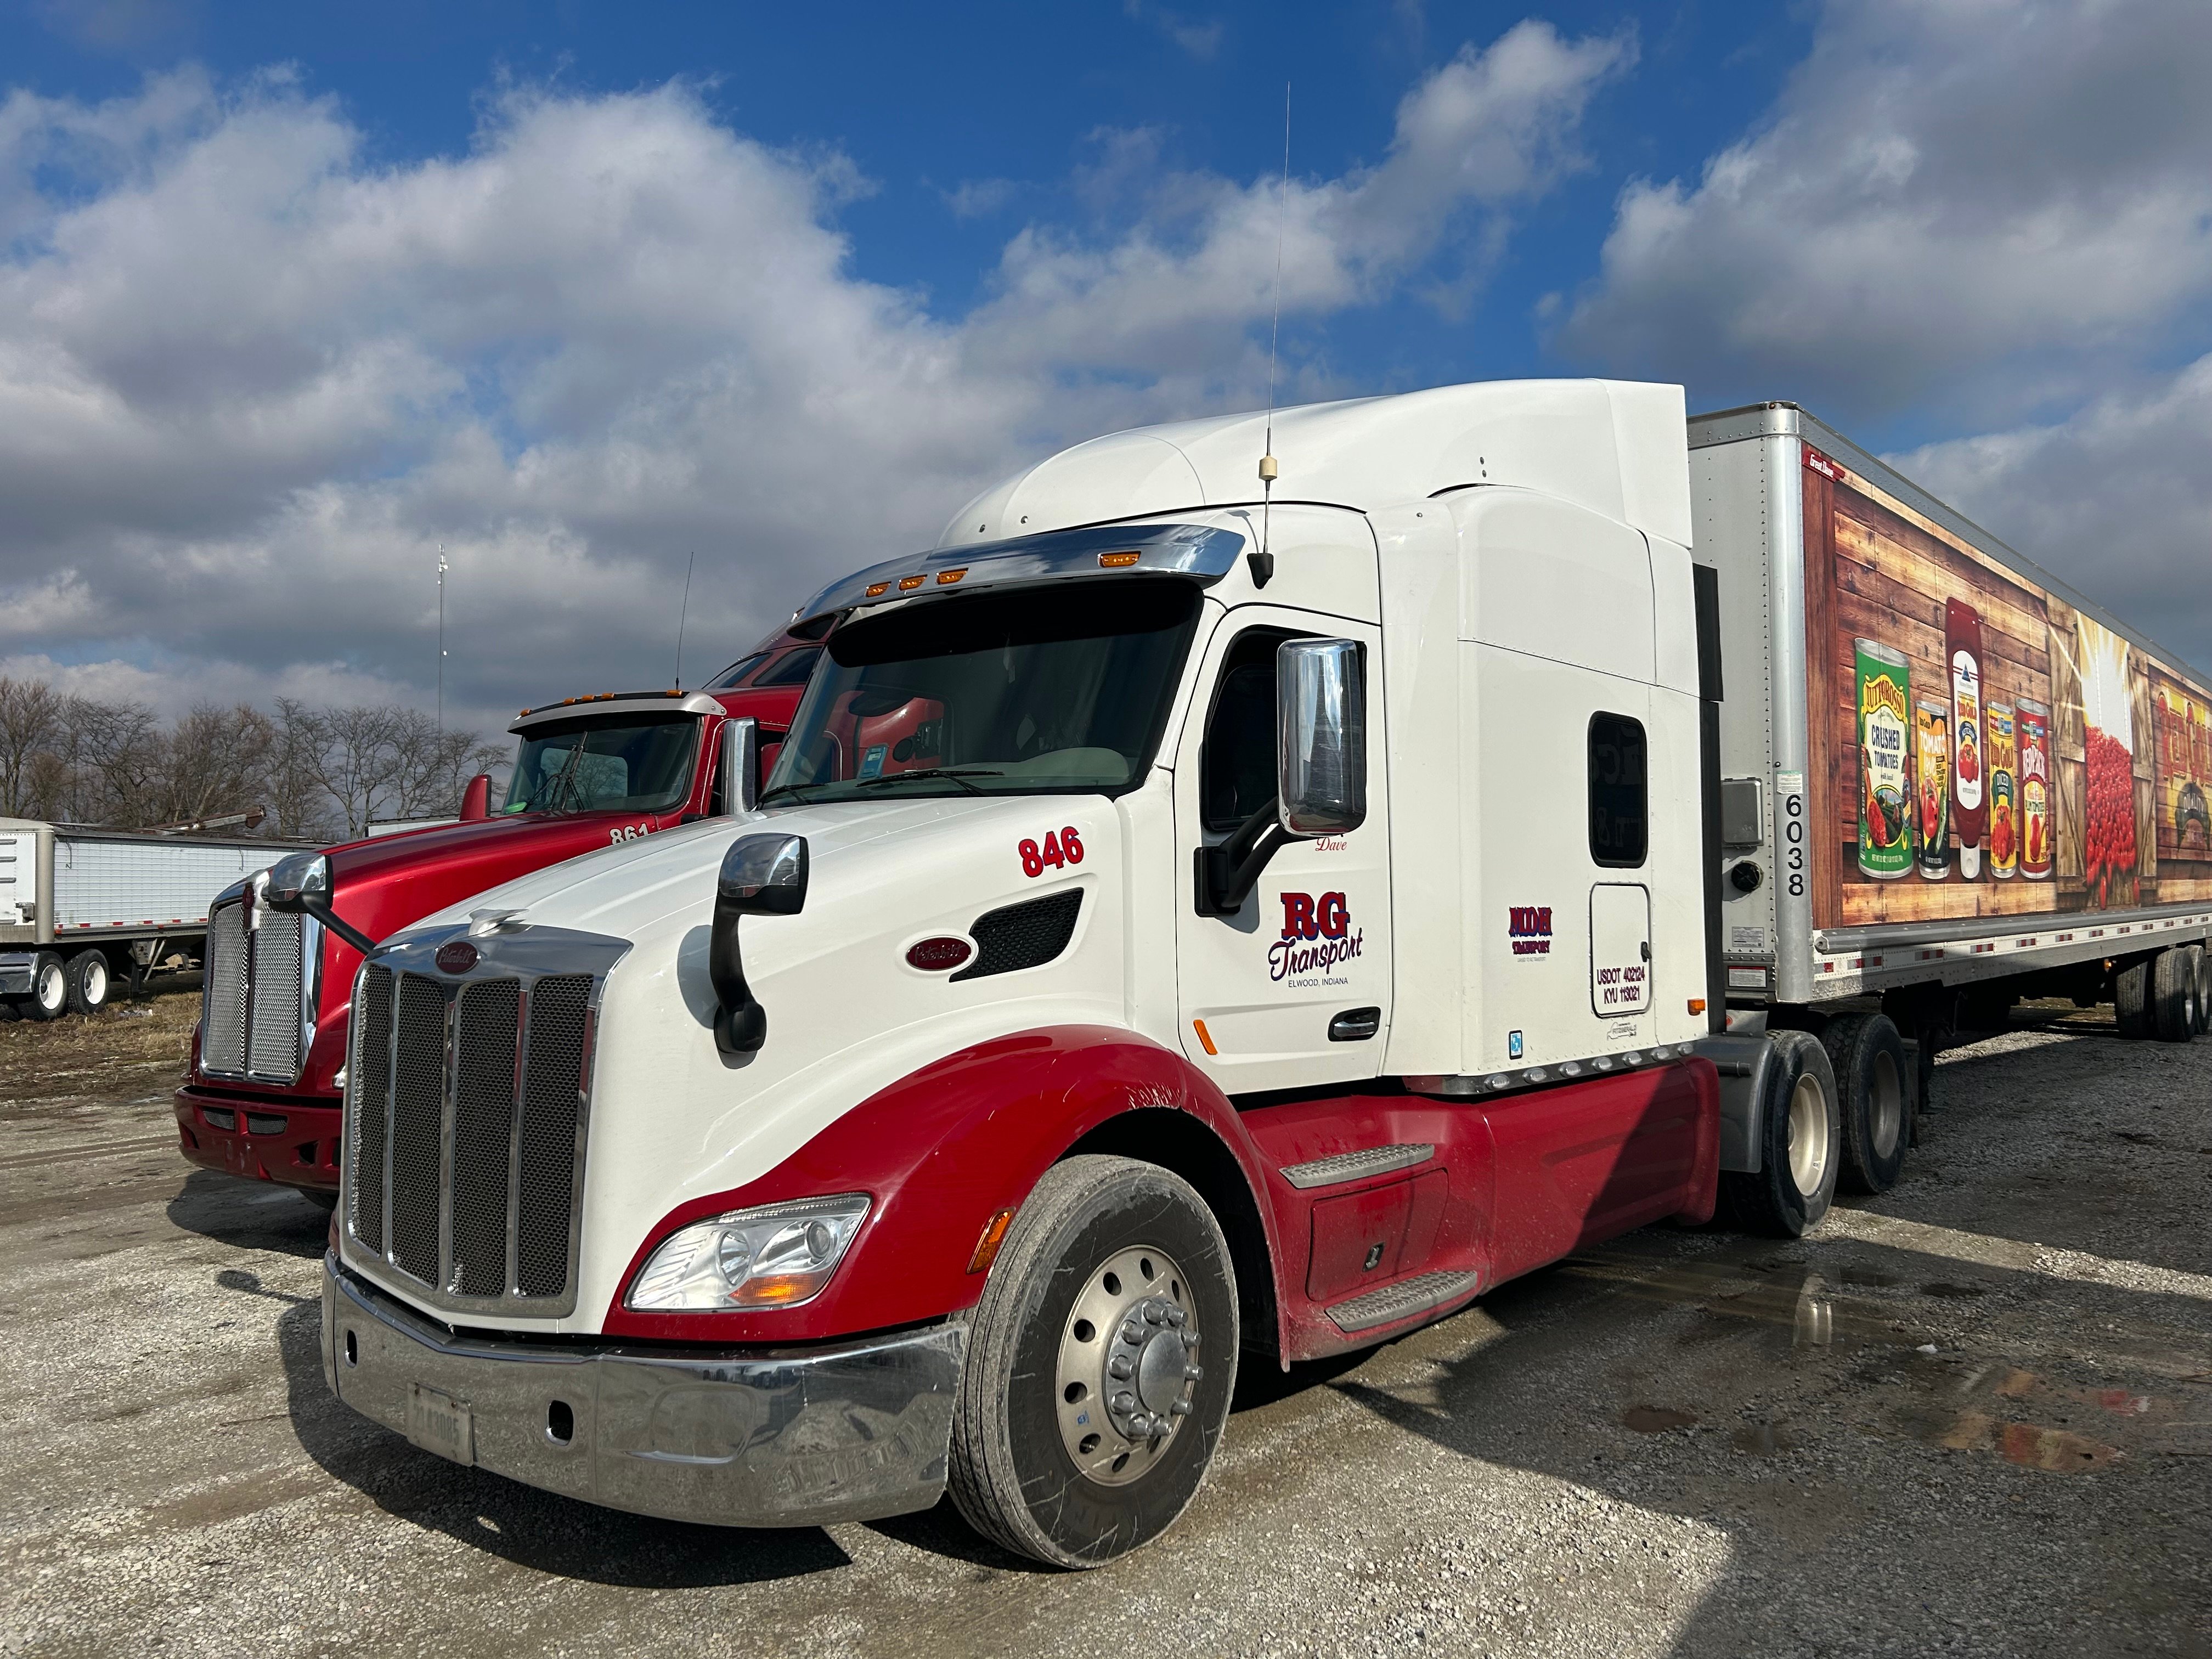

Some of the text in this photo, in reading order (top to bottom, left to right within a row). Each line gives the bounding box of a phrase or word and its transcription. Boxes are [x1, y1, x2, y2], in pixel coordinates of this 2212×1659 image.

[1871, 724, 1900, 751] CRUSHED
[1874, 750, 1899, 769] TOMATOES
[610, 822, 648, 845] 861
[1315, 837, 1347, 851] Dave
[1018, 826, 1084, 878] 846
[1786, 794, 1804, 896] 6038
[1280, 891, 1351, 941] RG
[438, 947, 476, 964] Peterbilt
[915, 944, 966, 965] Peterbilt
[1268, 927, 1363, 981] Transport
[1288, 977, 1348, 988] ELWOOD, INDIANA
[1596, 967, 1621, 985] USDOT
[1604, 987, 1618, 1005] KYU
